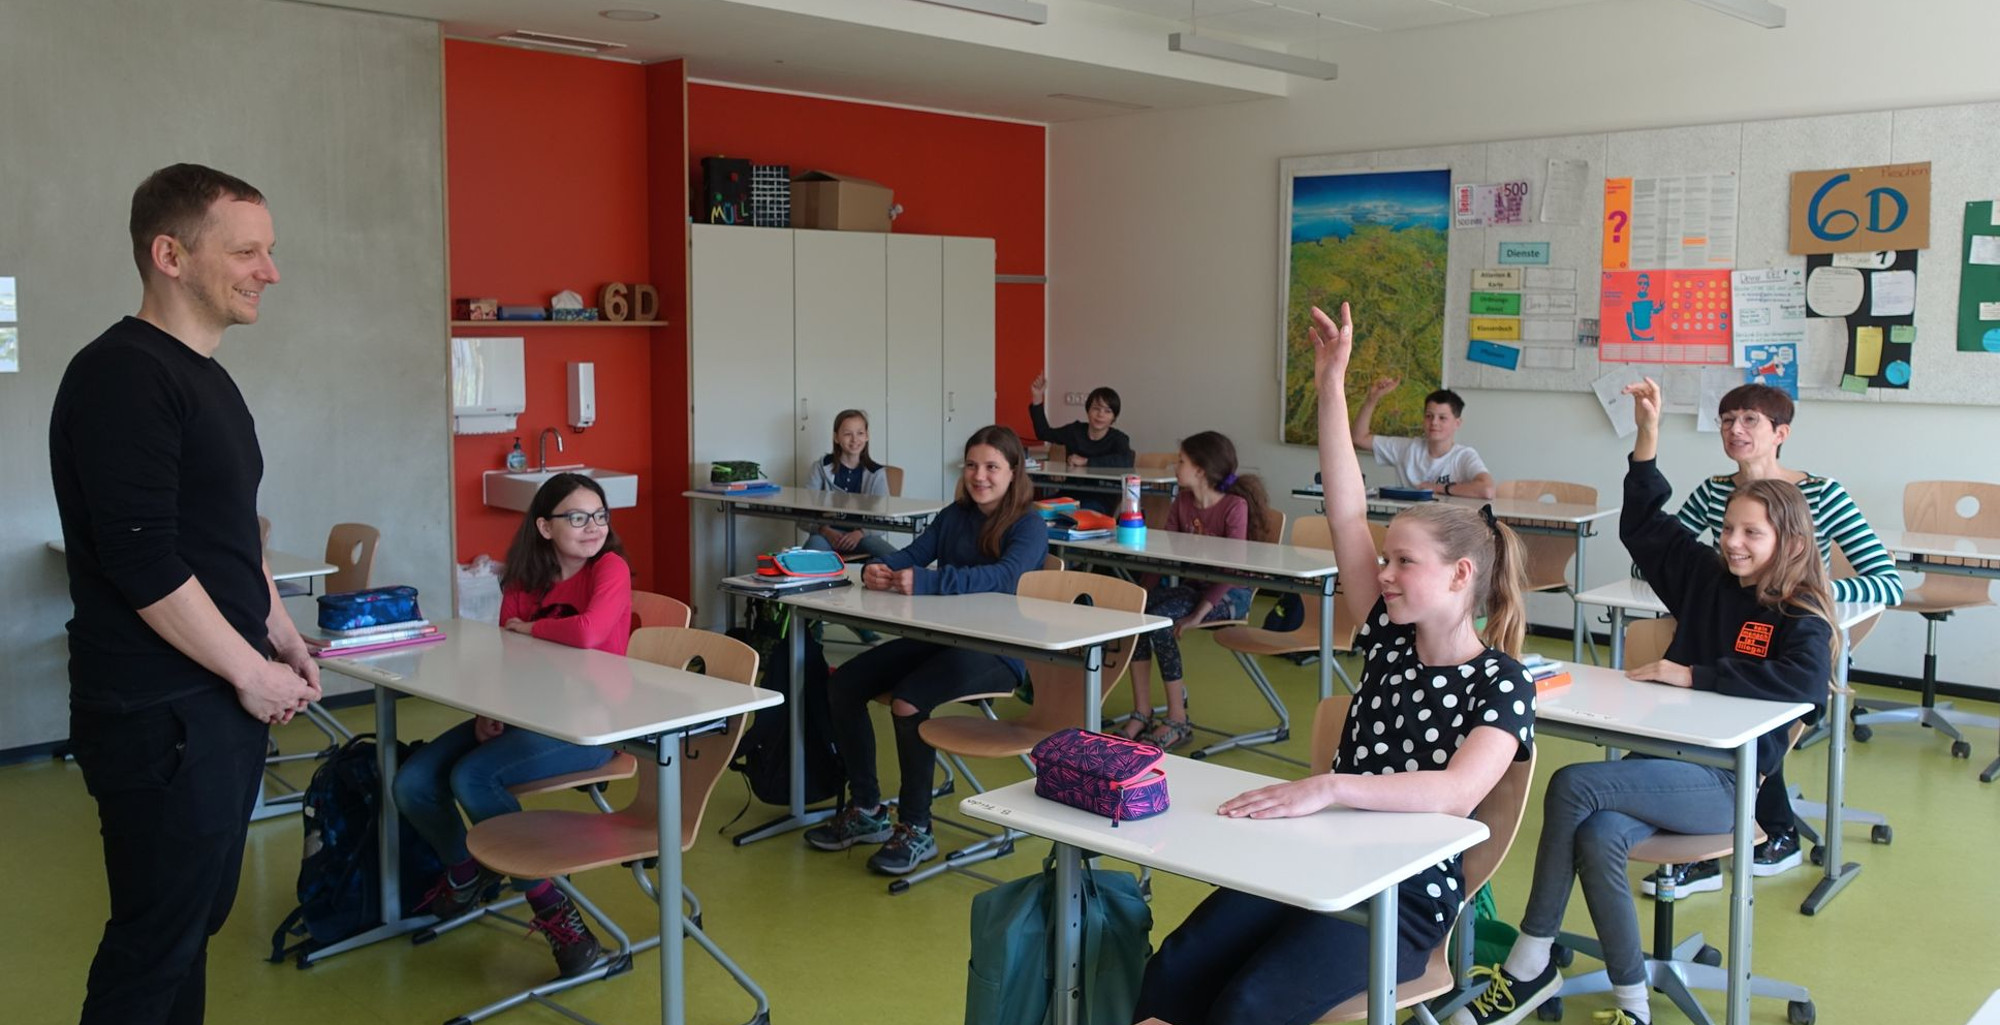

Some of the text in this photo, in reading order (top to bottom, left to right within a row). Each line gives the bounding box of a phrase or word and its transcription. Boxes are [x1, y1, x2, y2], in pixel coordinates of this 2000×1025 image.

[1503, 182, 1528, 197] 500
[711, 202, 749, 224] MÜLL
[1507, 249, 1540, 258] Dienste
[604, 282, 659, 321] 6D
